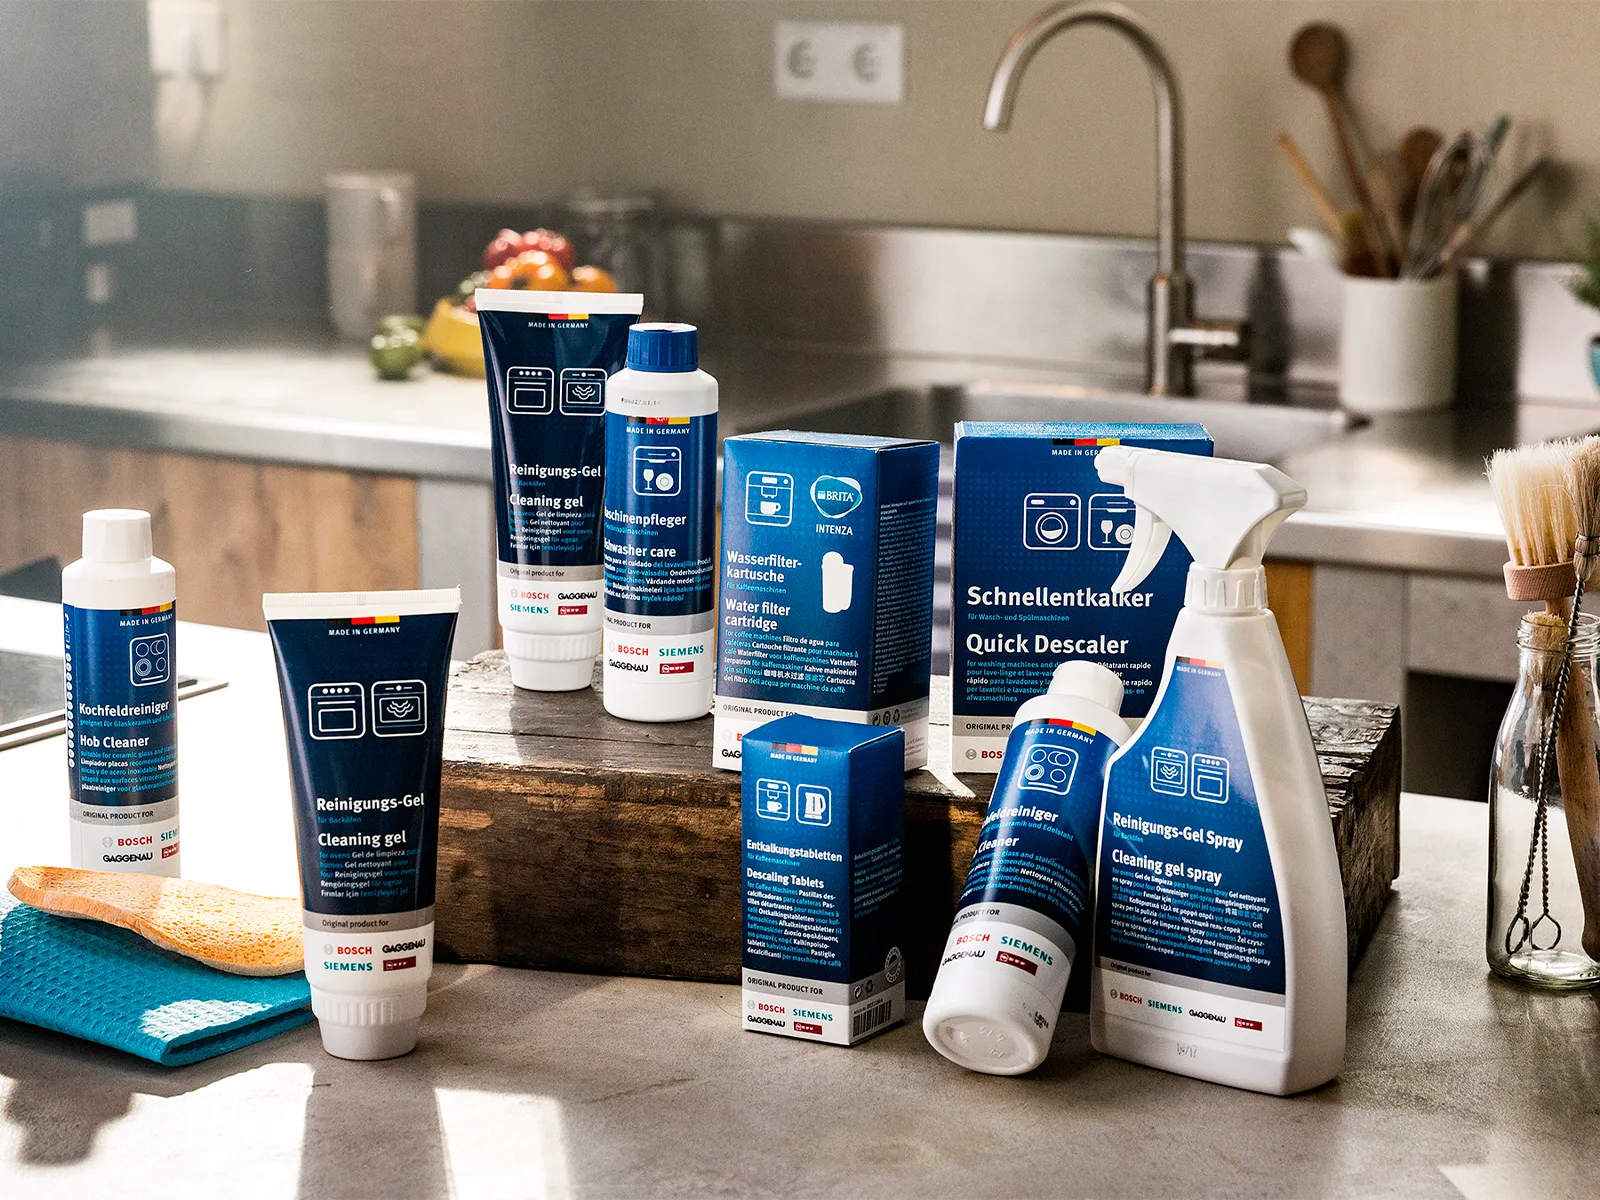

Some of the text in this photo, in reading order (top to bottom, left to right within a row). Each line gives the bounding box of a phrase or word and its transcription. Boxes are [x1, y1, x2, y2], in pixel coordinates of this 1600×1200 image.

[510, 464, 600, 479] Reinigungs-Gel
[510, 494, 583, 509] Cleaning gel
[826, 490, 853, 502] BRITA
[816, 524, 853, 535] INTENZA
[650, 547, 676, 557] care
[727, 550, 802, 568] Wasserfilter-
[727, 565, 784, 583] kartusche
[738, 583, 786, 594] Kaffeemaschinen
[558, 592, 597, 600] GAGGENAU
[967, 586, 1153, 607] Schnellentkalker
[510, 604, 549, 614] SIEMENS
[726, 598, 790, 616] Water filter
[151, 614, 172, 623] GERMANY
[614, 619, 637, 628] PRODUCT
[725, 616, 777, 632] cartridge
[1019, 614, 1069, 622] Spülmaschinen
[363, 627, 400, 635] GERMANY
[735, 631, 752, 639] coffee
[753, 632, 781, 640] machines
[783, 635, 798, 644] Filtro
[826, 640, 839, 648] para
[966, 634, 1129, 655] Quick Descaler
[618, 645, 704, 656] BOSCH SIEMENS
[725, 639, 751, 648] cafeteras
[752, 642, 781, 650] Cartouche
[824, 649, 853, 658] machines
[738, 649, 829, 665] Waterfilter koffiemachines
[609, 659, 648, 672] GAGGENAU
[804, 665, 857, 676] Kahve makineleri
[1198, 669, 1221, 677] GERMANY
[792, 683, 820, 691] macchine
[826, 676, 855, 685] Cartuccia
[79, 701, 169, 716] Kochfeldreiniger
[723, 704, 784, 717] ORIGINAL PRODUCT
[114, 719, 151, 727] Glaskeramik
[80, 734, 149, 748] Hob Cleaner
[1025, 727, 1043, 736] MADE
[1057, 729, 1094, 744] GERMANY
[138, 749, 153, 758] glass
[792, 756, 817, 764] GERMANY
[317, 793, 424, 813] Reinigungs-Gel
[83, 811, 109, 819] ORIGINAL
[318, 830, 406, 848] Cleaning gel
[1043, 824, 1073, 841] Edelstahl
[1113, 812, 1243, 853] Reinigungs-Gel Spray
[118, 836, 152, 846] BOSCH
[978, 836, 1019, 853] Cleaner
[103, 852, 153, 862] GAGGENAU
[376, 850, 405, 858] limpieza
[747, 839, 842, 862] Entkalkungstabletten
[358, 861, 391, 869] nettoyant
[1112, 849, 1222, 886] Cleaning gel spray
[335, 870, 383, 879] Reinigingsgel
[747, 868, 824, 888] Descaling Tablets
[1020, 868, 1053, 884] Nettoyant
[321, 880, 370, 889] Rengöringsgel
[346, 890, 359, 898] için
[322, 920, 348, 928] Original
[350, 921, 377, 929] product
[337, 938, 426, 955] BOSCH GAGGENAU
[956, 934, 990, 945] BOSCH
[1001, 936, 1053, 966] SIEMENS
[324, 962, 373, 971] SIEMENS
[1111, 962, 1144, 975] Original product
[748, 977, 823, 995] ORIGINAL PRODUCT FOR
[758, 1003, 833, 1021] BOSCH SIEMENS
[1120, 992, 1226, 1023] BOSCH SIEMENS GAGGENAU
[747, 1015, 785, 1027] GAGGENAU
